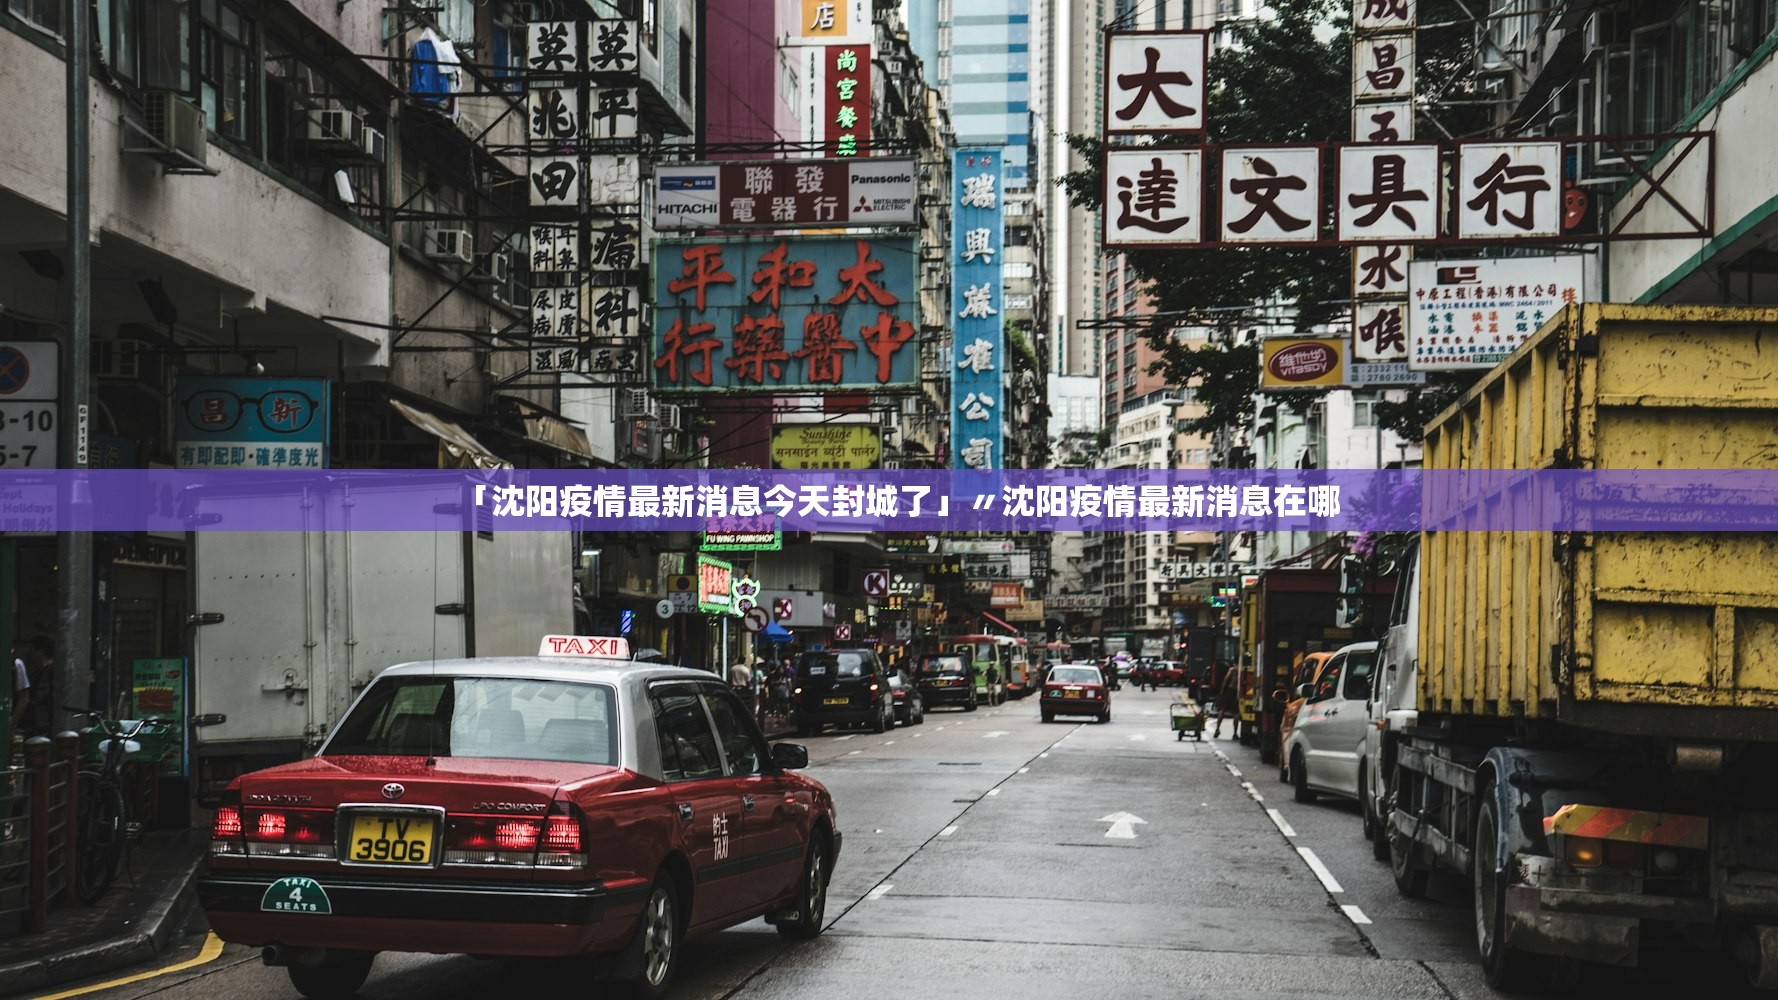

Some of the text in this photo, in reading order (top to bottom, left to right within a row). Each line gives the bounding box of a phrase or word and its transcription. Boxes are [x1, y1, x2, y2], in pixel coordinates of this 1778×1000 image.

[810, 2, 835, 30] 店
[1115, 46, 1197, 121] 大
[744, 165, 824, 195] 聯發
[851, 173, 911, 185] Panasonic
[873, 197, 911, 205] MITSUBISHI
[1116, 152, 1551, 234] 達文具行
[658, 203, 717, 214] HITACHI
[730, 196, 839, 222] 電器行
[873, 204, 906, 212] ELECTRIC
[668, 239, 899, 313] 太和平
[1359, 245, 1406, 355] 水喉
[653, 311, 916, 386] 中醫藥行
[1280, 361, 1328, 376] vitasoy
[800, 427, 852, 440] Sunshine
[706, 534, 716, 543] FU
[716, 534, 735, 544] WING
[549, 638, 618, 655] TAXI
[497, 802, 546, 811] COMFORT
[378, 817, 412, 841] TV
[356, 838, 426, 862] 3906
[713, 836, 729, 860] TAXI
[283, 878, 312, 889] TAXI
[289, 888, 302, 902] 4
[275, 901, 317, 912] SEATS
